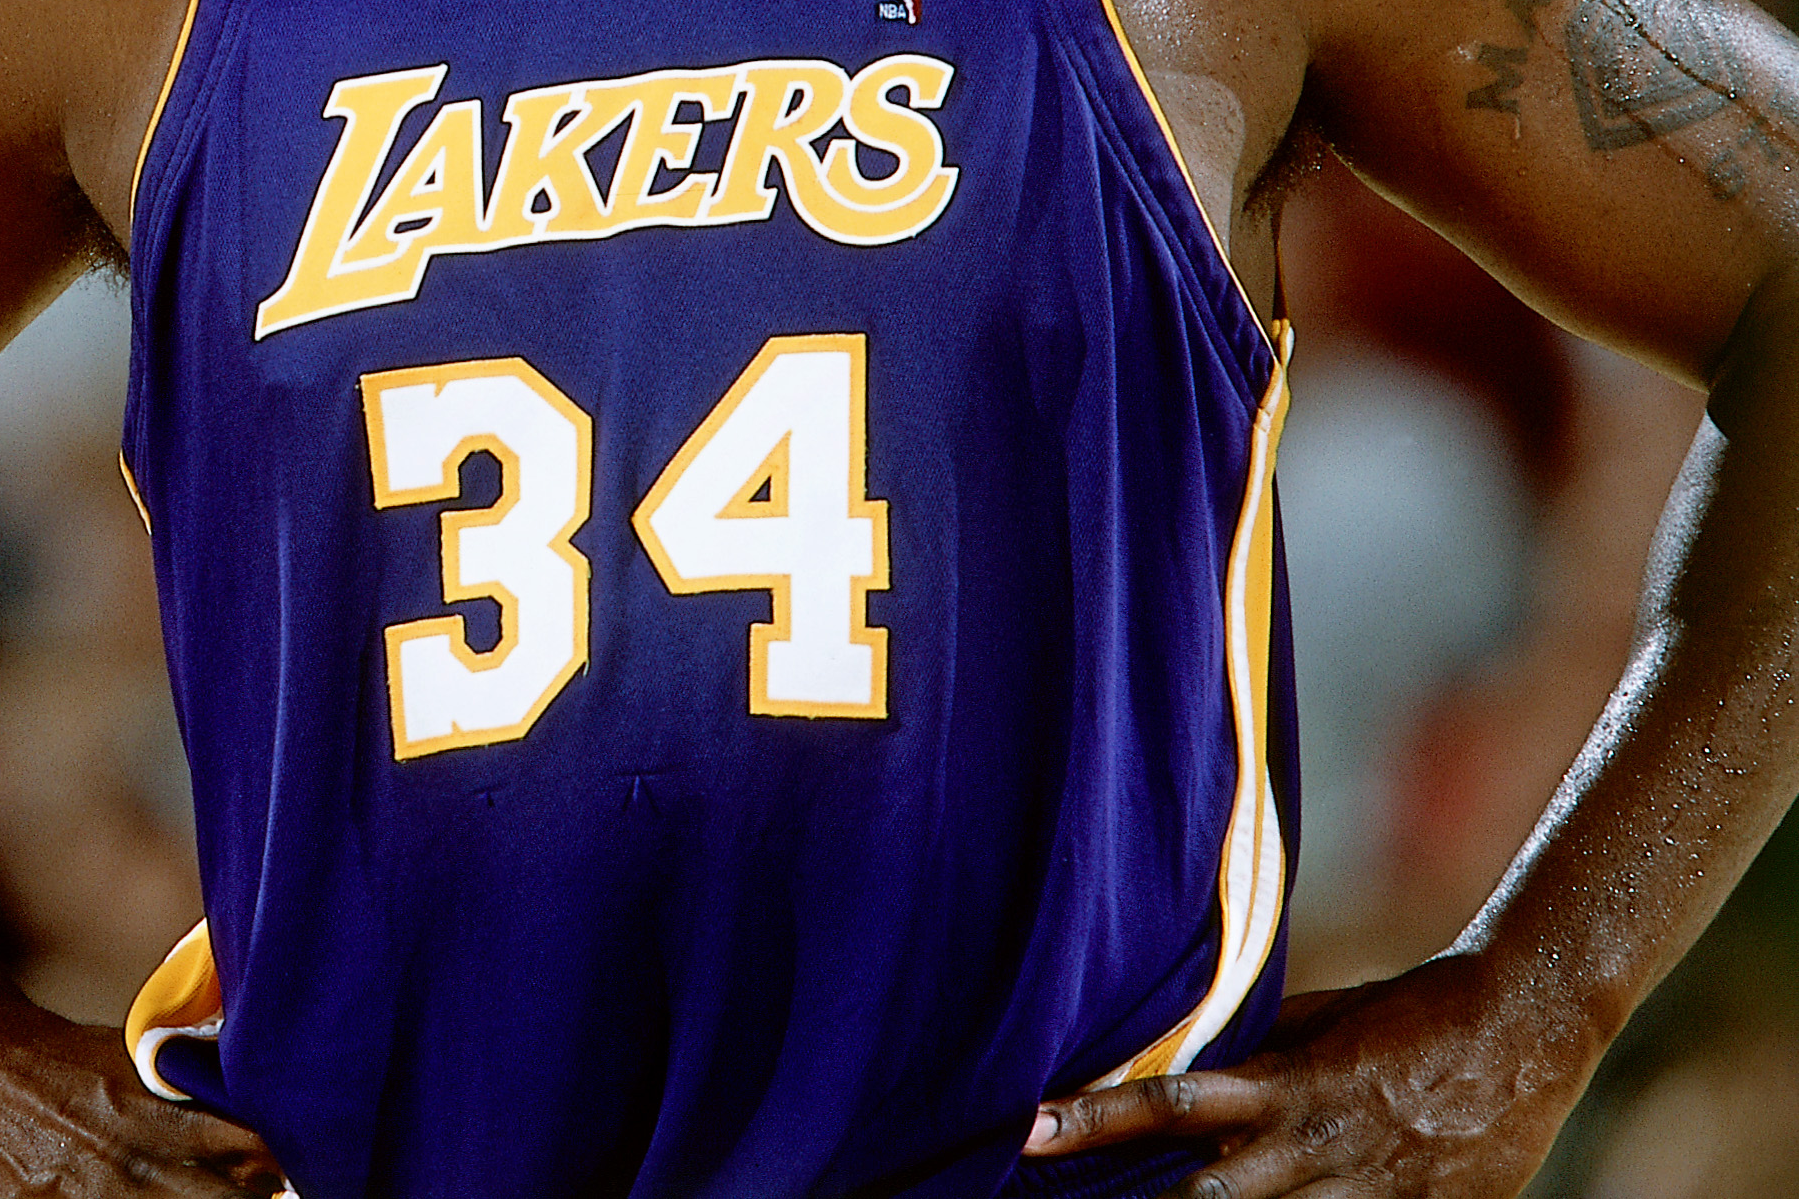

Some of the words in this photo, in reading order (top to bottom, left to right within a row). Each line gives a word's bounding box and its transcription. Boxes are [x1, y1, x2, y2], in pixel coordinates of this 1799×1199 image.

[878, 3, 907, 19] NBA
[255, 54, 959, 342] LAKERS
[359, 333, 890, 761] 34
